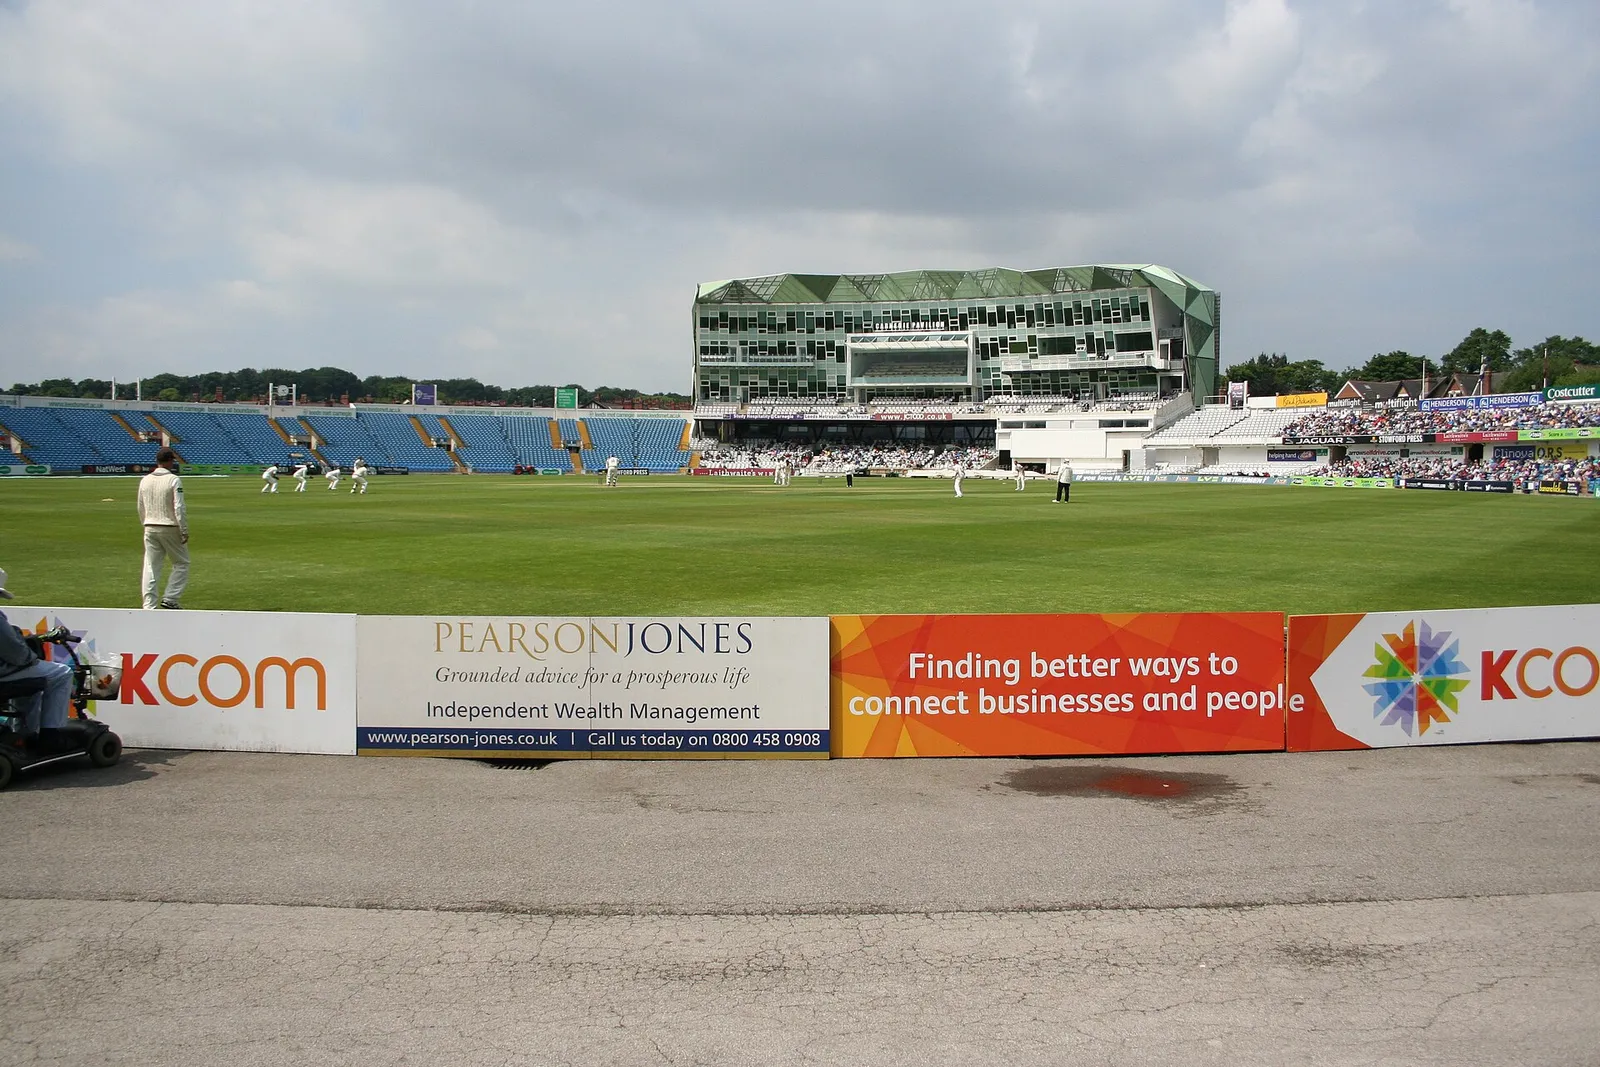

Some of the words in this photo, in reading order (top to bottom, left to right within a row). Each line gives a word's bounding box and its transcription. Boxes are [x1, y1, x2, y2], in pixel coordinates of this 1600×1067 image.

[875, 322, 909, 330] CARNEGIE
[912, 321, 945, 330] PAVILION
[1547, 386, 1595, 399] Costcutter
[1327, 399, 1361, 409] multiflight
[1374, 397, 1418, 410] mltiflight
[1430, 399, 1466, 408] HENDERSON
[1489, 396, 1529, 405] HENDERSON
[1378, 434, 1406, 443] STOWFORD
[1406, 434, 1423, 443] PRESS
[1268, 452, 1285, 460] helping
[1494, 447, 1535, 459] Clinova
[95, 465, 126, 473] NatWest
[633, 468, 648, 476] PRESS
[709, 468, 756, 476] Laithwaite's
[1221, 476, 1268, 484] RETIREMENT
[908, 652, 1021, 685] Finding
[1030, 651, 1121, 678] better
[1128, 656, 1201, 683] ways
[1208, 652, 1239, 675] to
[1481, 646, 1600, 700] KCO
[435, 666, 521, 683] Grounded
[525, 666, 578, 683] advice
[577, 666, 608, 689] for
[612, 670, 622, 684] a
[624, 668, 718, 690] prosperous
[723, 666, 750, 690] life
[848, 691, 970, 716] connect
[979, 687, 1134, 715] businesses
[1142, 684, 1197, 712] and
[1206, 683, 1305, 717] people
[427, 701, 549, 721] Independent
[554, 702, 623, 719] Wealth
[630, 703, 760, 723] Management
[367, 731, 557, 748] www.pearson-jones.co.uk
[588, 732, 615, 746] Call
[620, 736, 637, 746] us
[641, 732, 684, 749] today
[688, 736, 708, 746] on
[712, 733, 749, 746] 0800
[752, 733, 780, 746] 458
[784, 733, 821, 746] 0908
